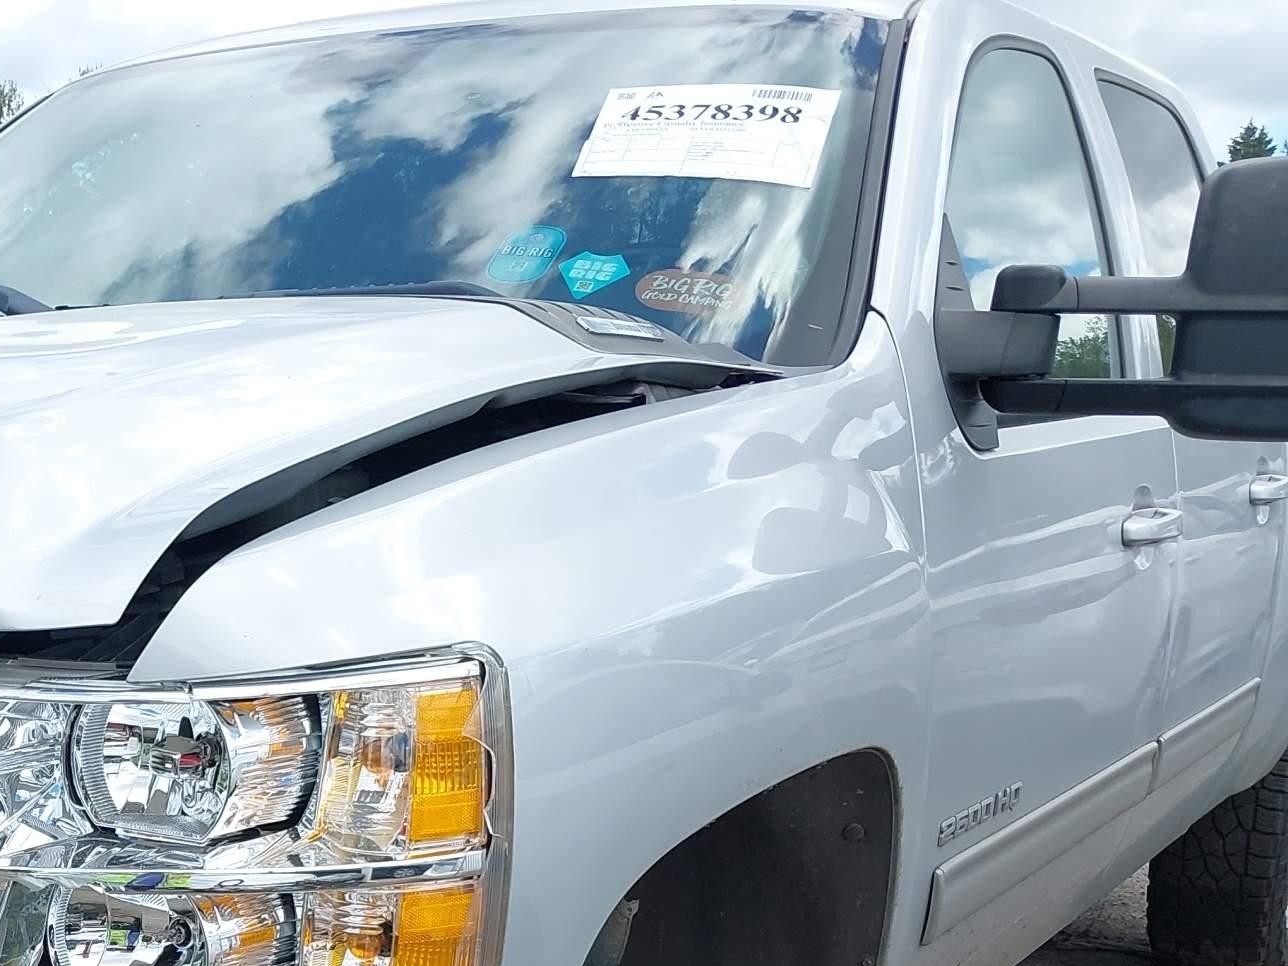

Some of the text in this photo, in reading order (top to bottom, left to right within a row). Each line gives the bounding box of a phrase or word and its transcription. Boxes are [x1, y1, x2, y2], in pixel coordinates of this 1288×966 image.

[620, 103, 803, 124] 45378398
[501, 245, 554, 258] BIG RIG
[573, 259, 619, 272] BIG
[569, 268, 614, 281] RIG
[649, 275, 732, 298] BIG RIG
